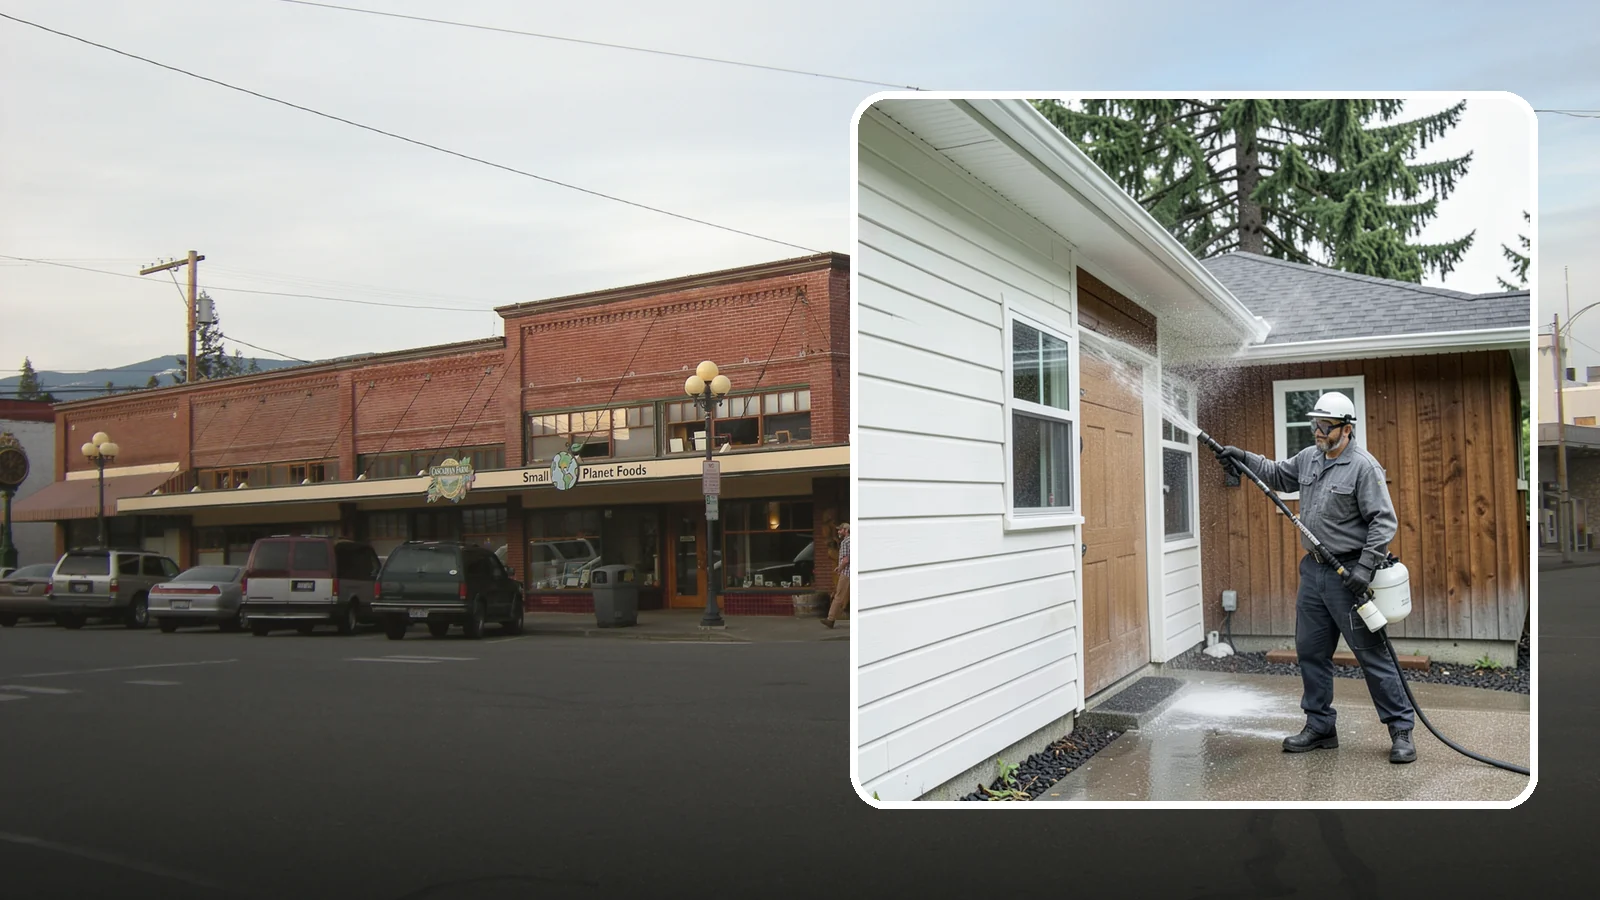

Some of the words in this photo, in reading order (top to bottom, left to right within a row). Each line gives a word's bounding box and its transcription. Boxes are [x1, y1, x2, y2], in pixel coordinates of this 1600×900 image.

[523, 471, 549, 483] Small
[583, 467, 614, 479] Planet
[617, 464, 647, 477] Foods
